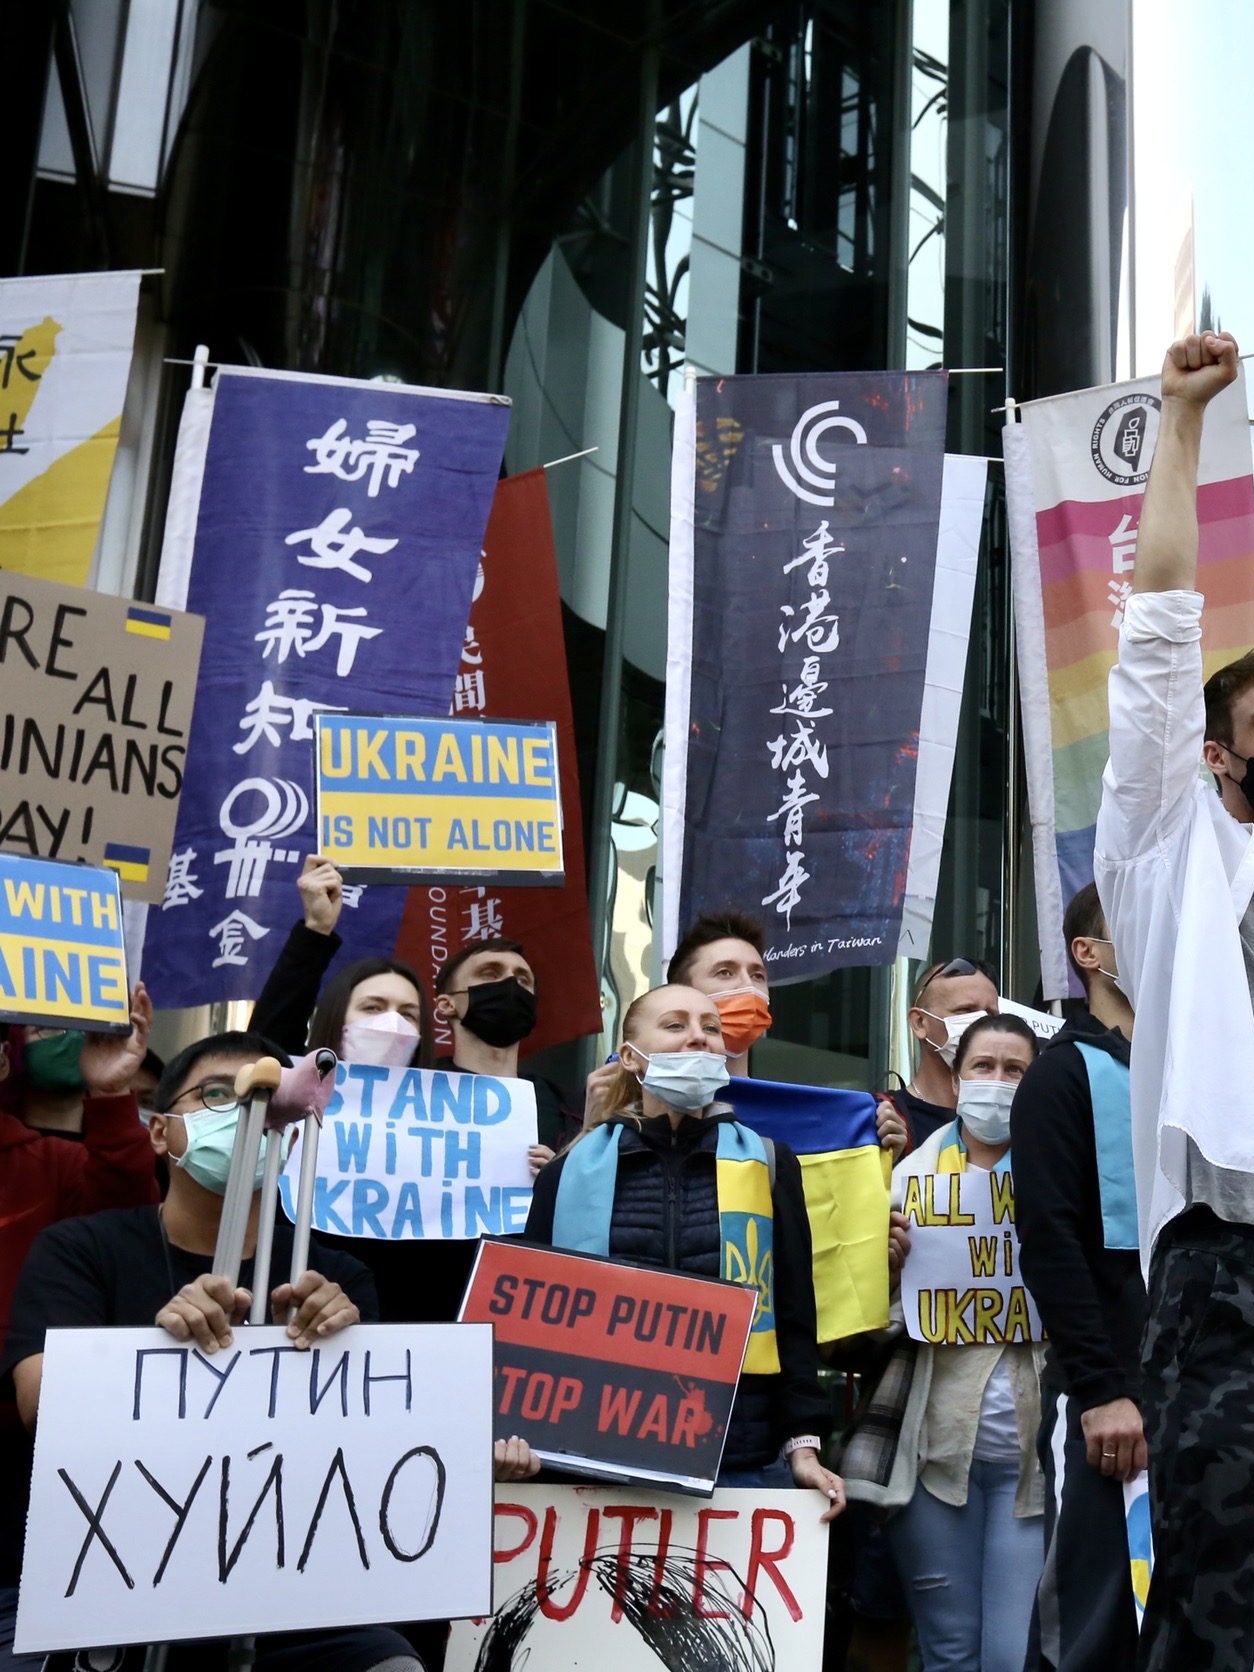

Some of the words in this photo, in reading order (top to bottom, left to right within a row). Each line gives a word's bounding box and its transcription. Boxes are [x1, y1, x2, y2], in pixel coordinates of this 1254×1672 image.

[1092, 417, 1106, 449] RIGHTS
[1093, 452, 1113, 478] HUMAN
[72, 666, 184, 738] ALL
[320, 727, 553, 787] UKRAINE
[0, 800, 94, 863] AY!
[322, 815, 354, 848] IS
[368, 816, 432, 849] NOT
[447, 818, 556, 852] ALONE
[3, 878, 119, 931] WITH
[810, 940, 824, 953] in
[827, 936, 882, 953] Taiwan
[323, 1063, 512, 1126] STAND
[903, 1173, 976, 1228] ALL
[488, 1273, 598, 1329] STOP
[606, 1293, 727, 1356] PUTIN
[918, 1285, 1034, 1345] UKRA
[132, 1346, 413, 1421] ПУТИН
[496, 1364, 584, 1426] TOP
[596, 1382, 705, 1449] WAR
[56, 1441, 447, 1599] ХУЙЛО
[493, 1503, 804, 1624] PUTLER
